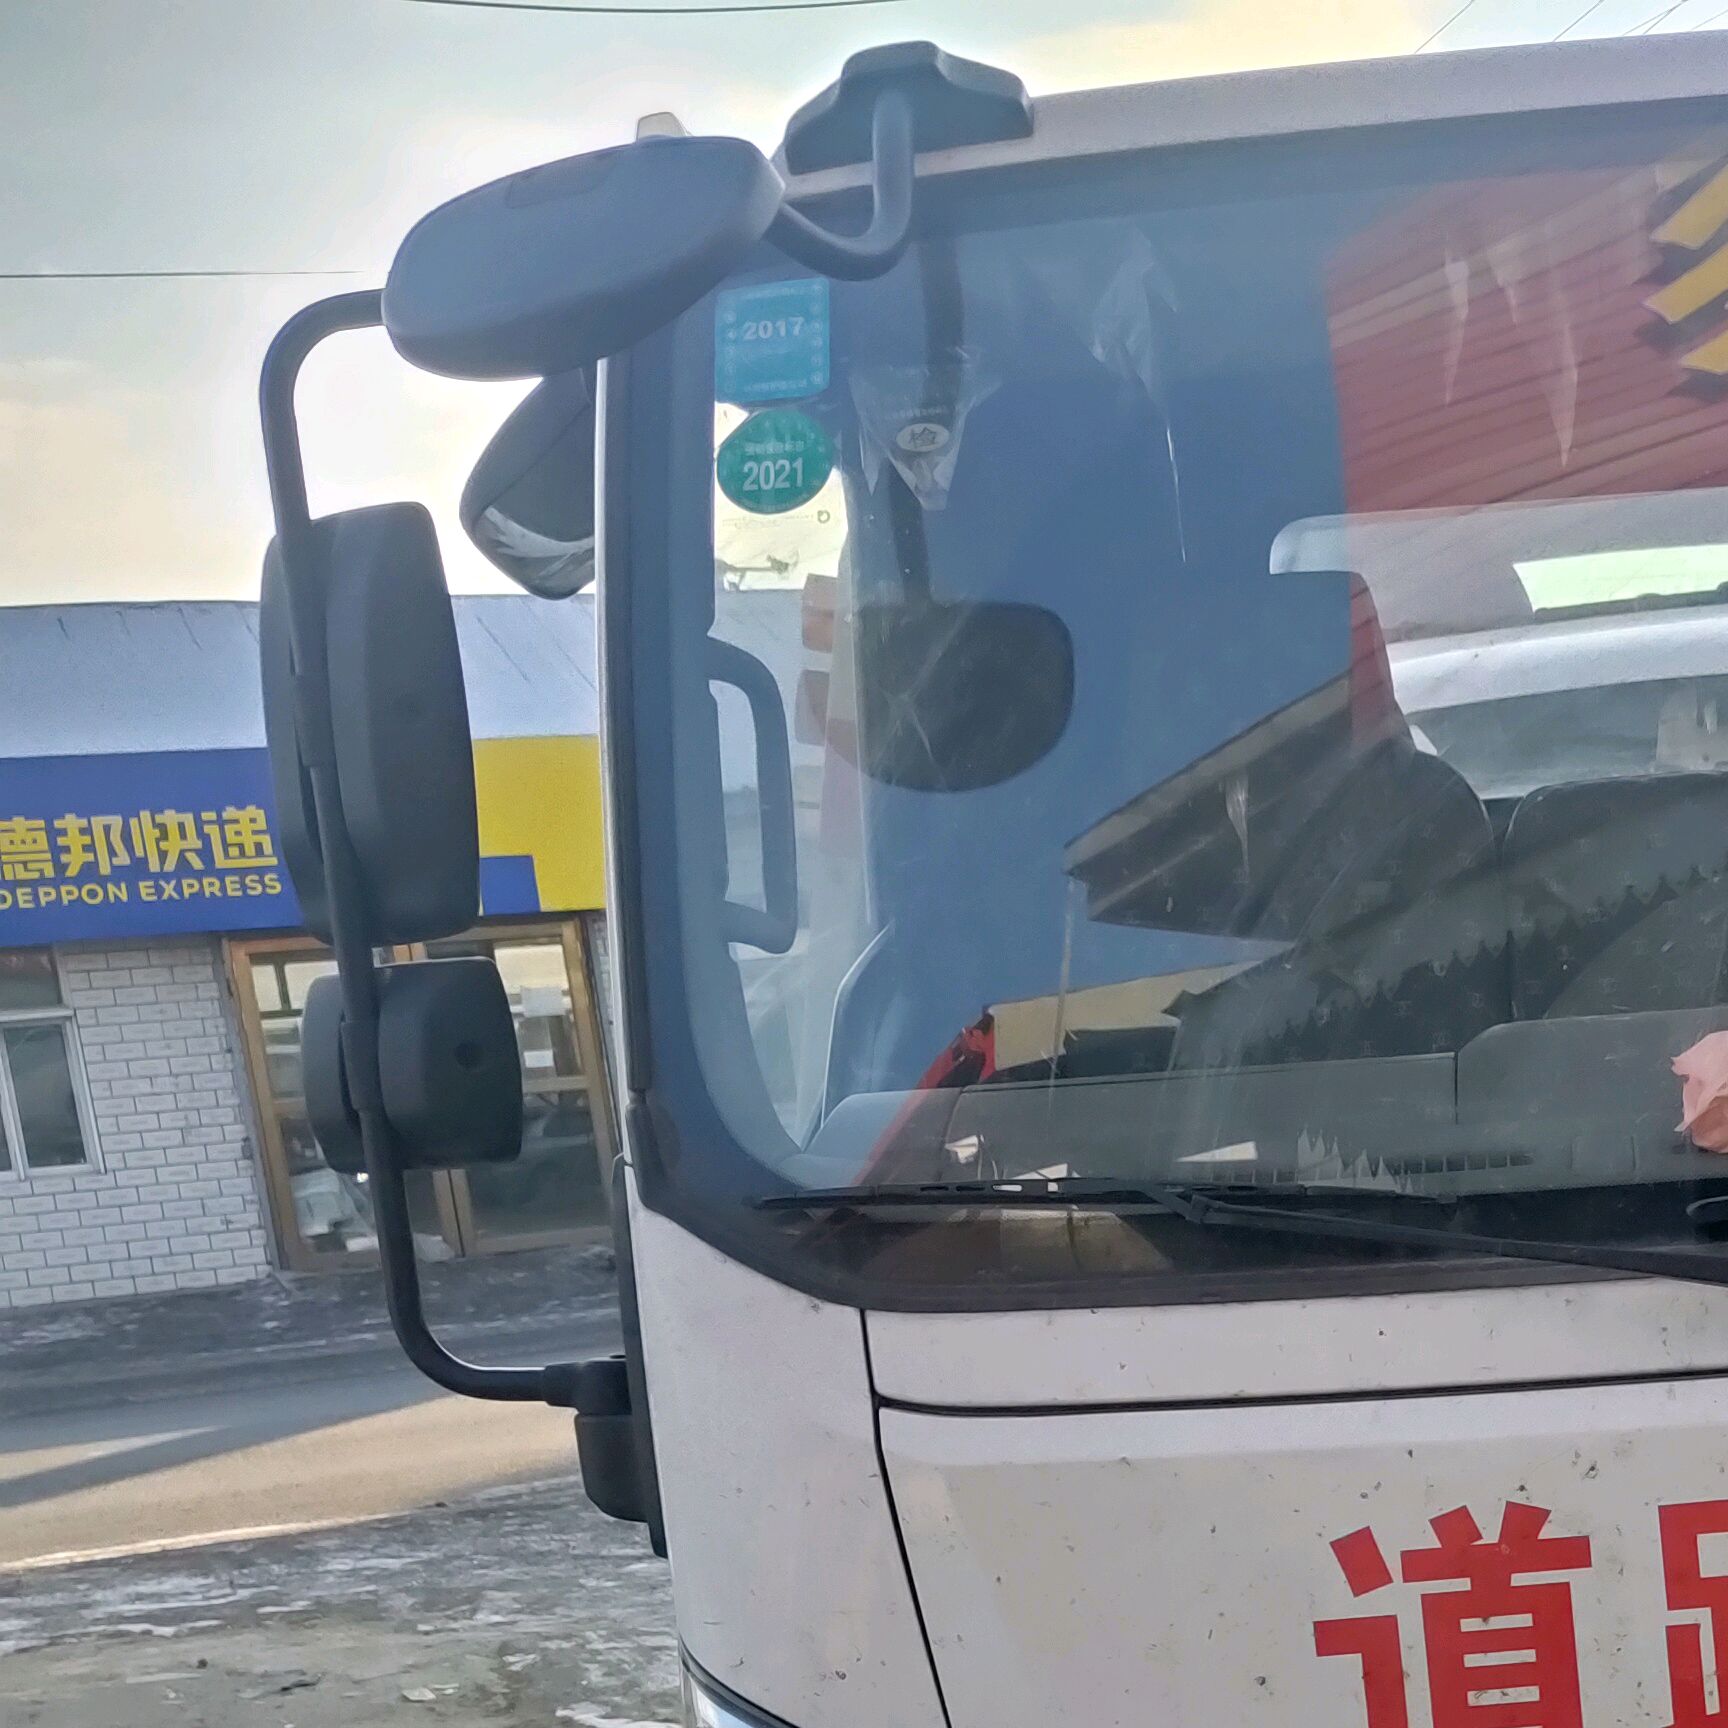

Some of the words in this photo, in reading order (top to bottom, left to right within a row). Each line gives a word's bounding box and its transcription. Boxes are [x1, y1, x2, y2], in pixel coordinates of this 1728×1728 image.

[742, 316, 805, 341] 2017
[743, 457, 804, 491] 2021
[0, 805, 279, 880] 德邦快递
[0, 882, 129, 910] DEPPON
[138, 873, 282, 901] EXPRESS
